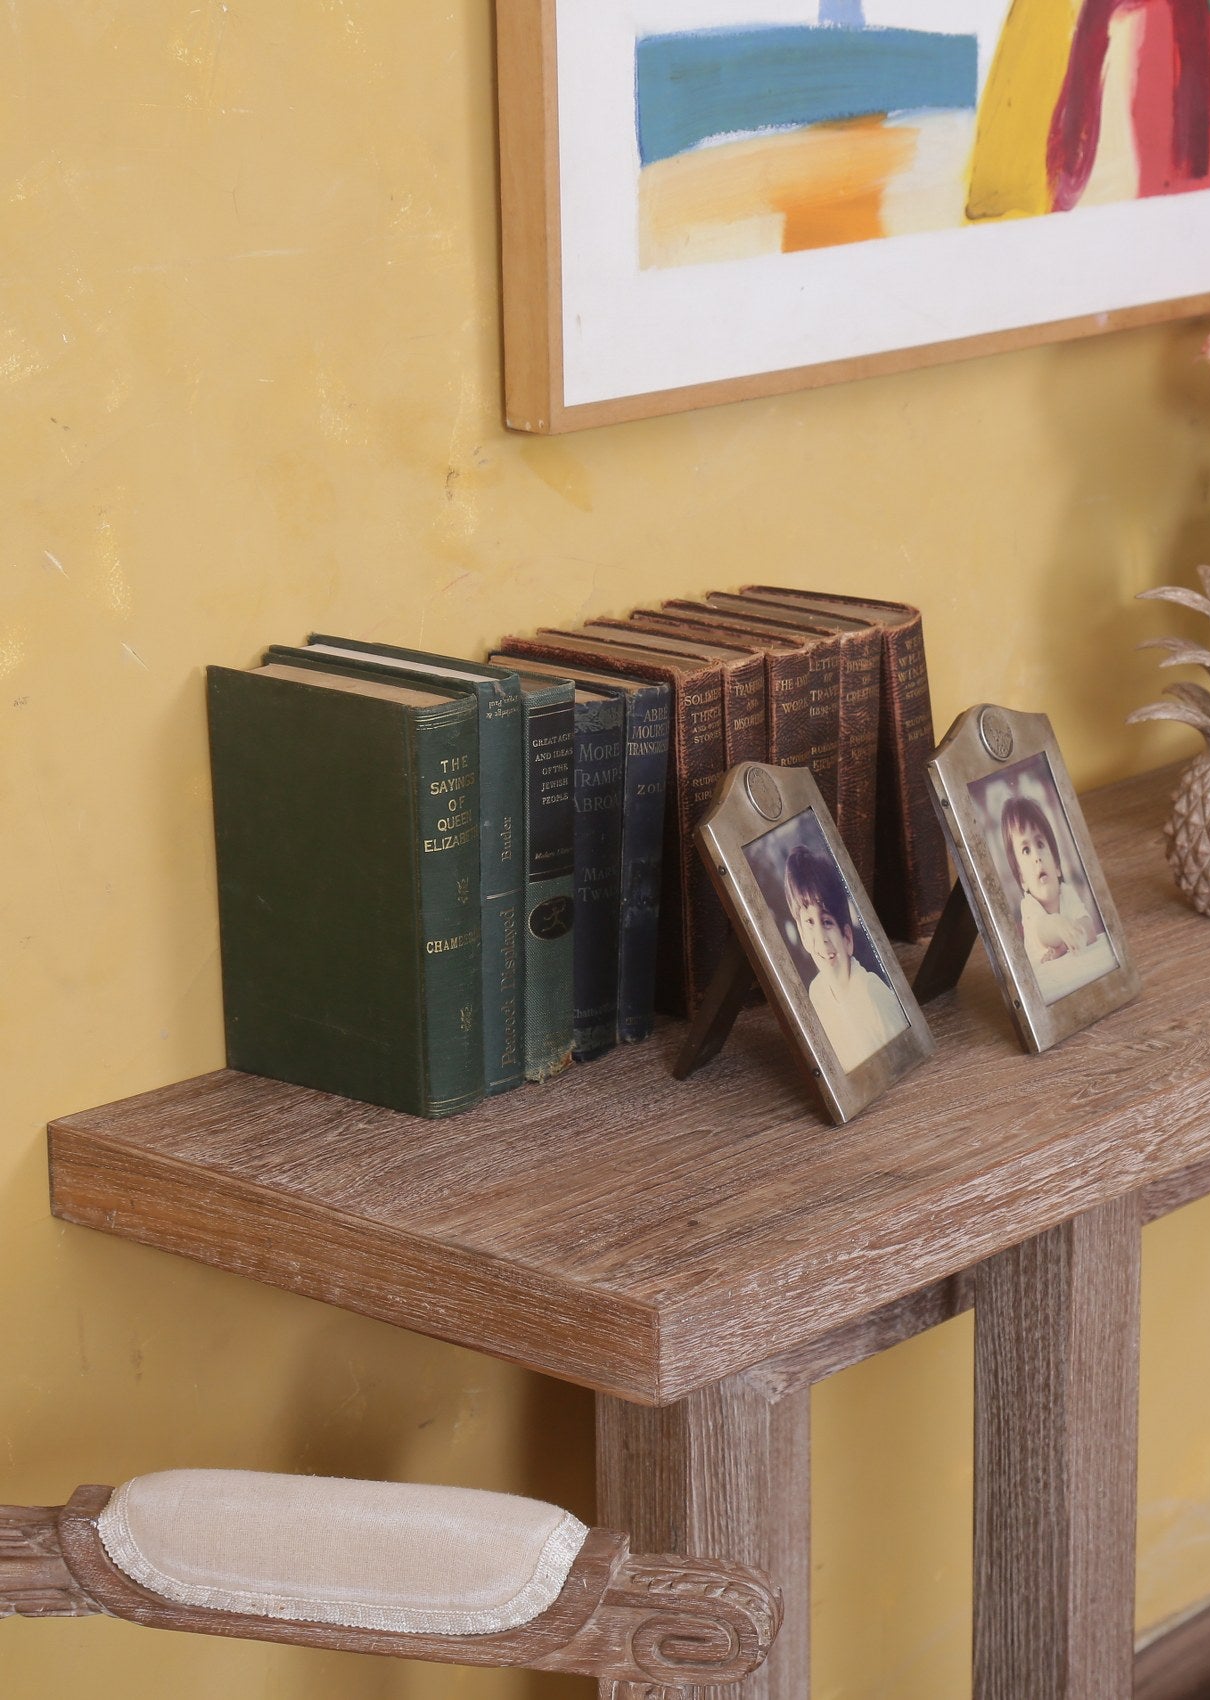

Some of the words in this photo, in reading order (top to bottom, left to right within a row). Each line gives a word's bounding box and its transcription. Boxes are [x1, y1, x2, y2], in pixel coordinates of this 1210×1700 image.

[535, 751, 552, 762] AND
[553, 747, 574, 759] IDEAS
[578, 742, 620, 762] MORE
[440, 755, 468, 774] THE
[542, 765, 552, 775] OF
[430, 772, 476, 796] SAYINGS
[541, 777, 569, 792] JEWISH
[448, 796, 466, 812] OF
[541, 793, 569, 806] PEOPLE
[437, 809, 473, 832] QUEEN
[500, 816, 512, 862] Butler
[499, 906, 517, 992] Displayed
[500, 998, 517, 1067] Peacock
